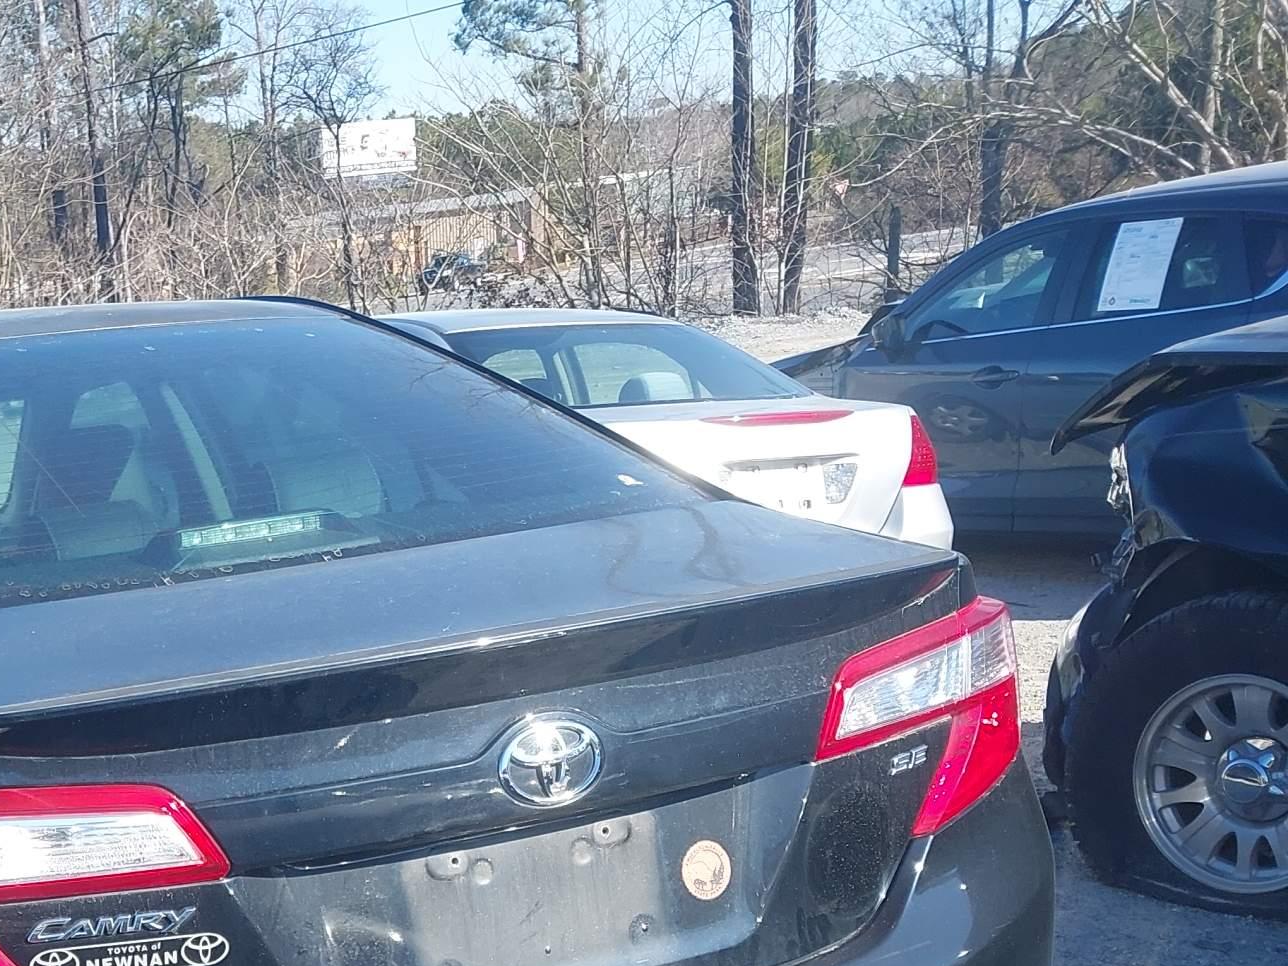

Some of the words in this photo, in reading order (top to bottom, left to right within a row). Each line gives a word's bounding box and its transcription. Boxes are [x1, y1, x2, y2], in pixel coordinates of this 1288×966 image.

[888, 744, 928, 776] SE
[26, 906, 197, 944] CAMRY
[107, 945, 148, 956] TOYOTA
[151, 942, 162, 951] of
